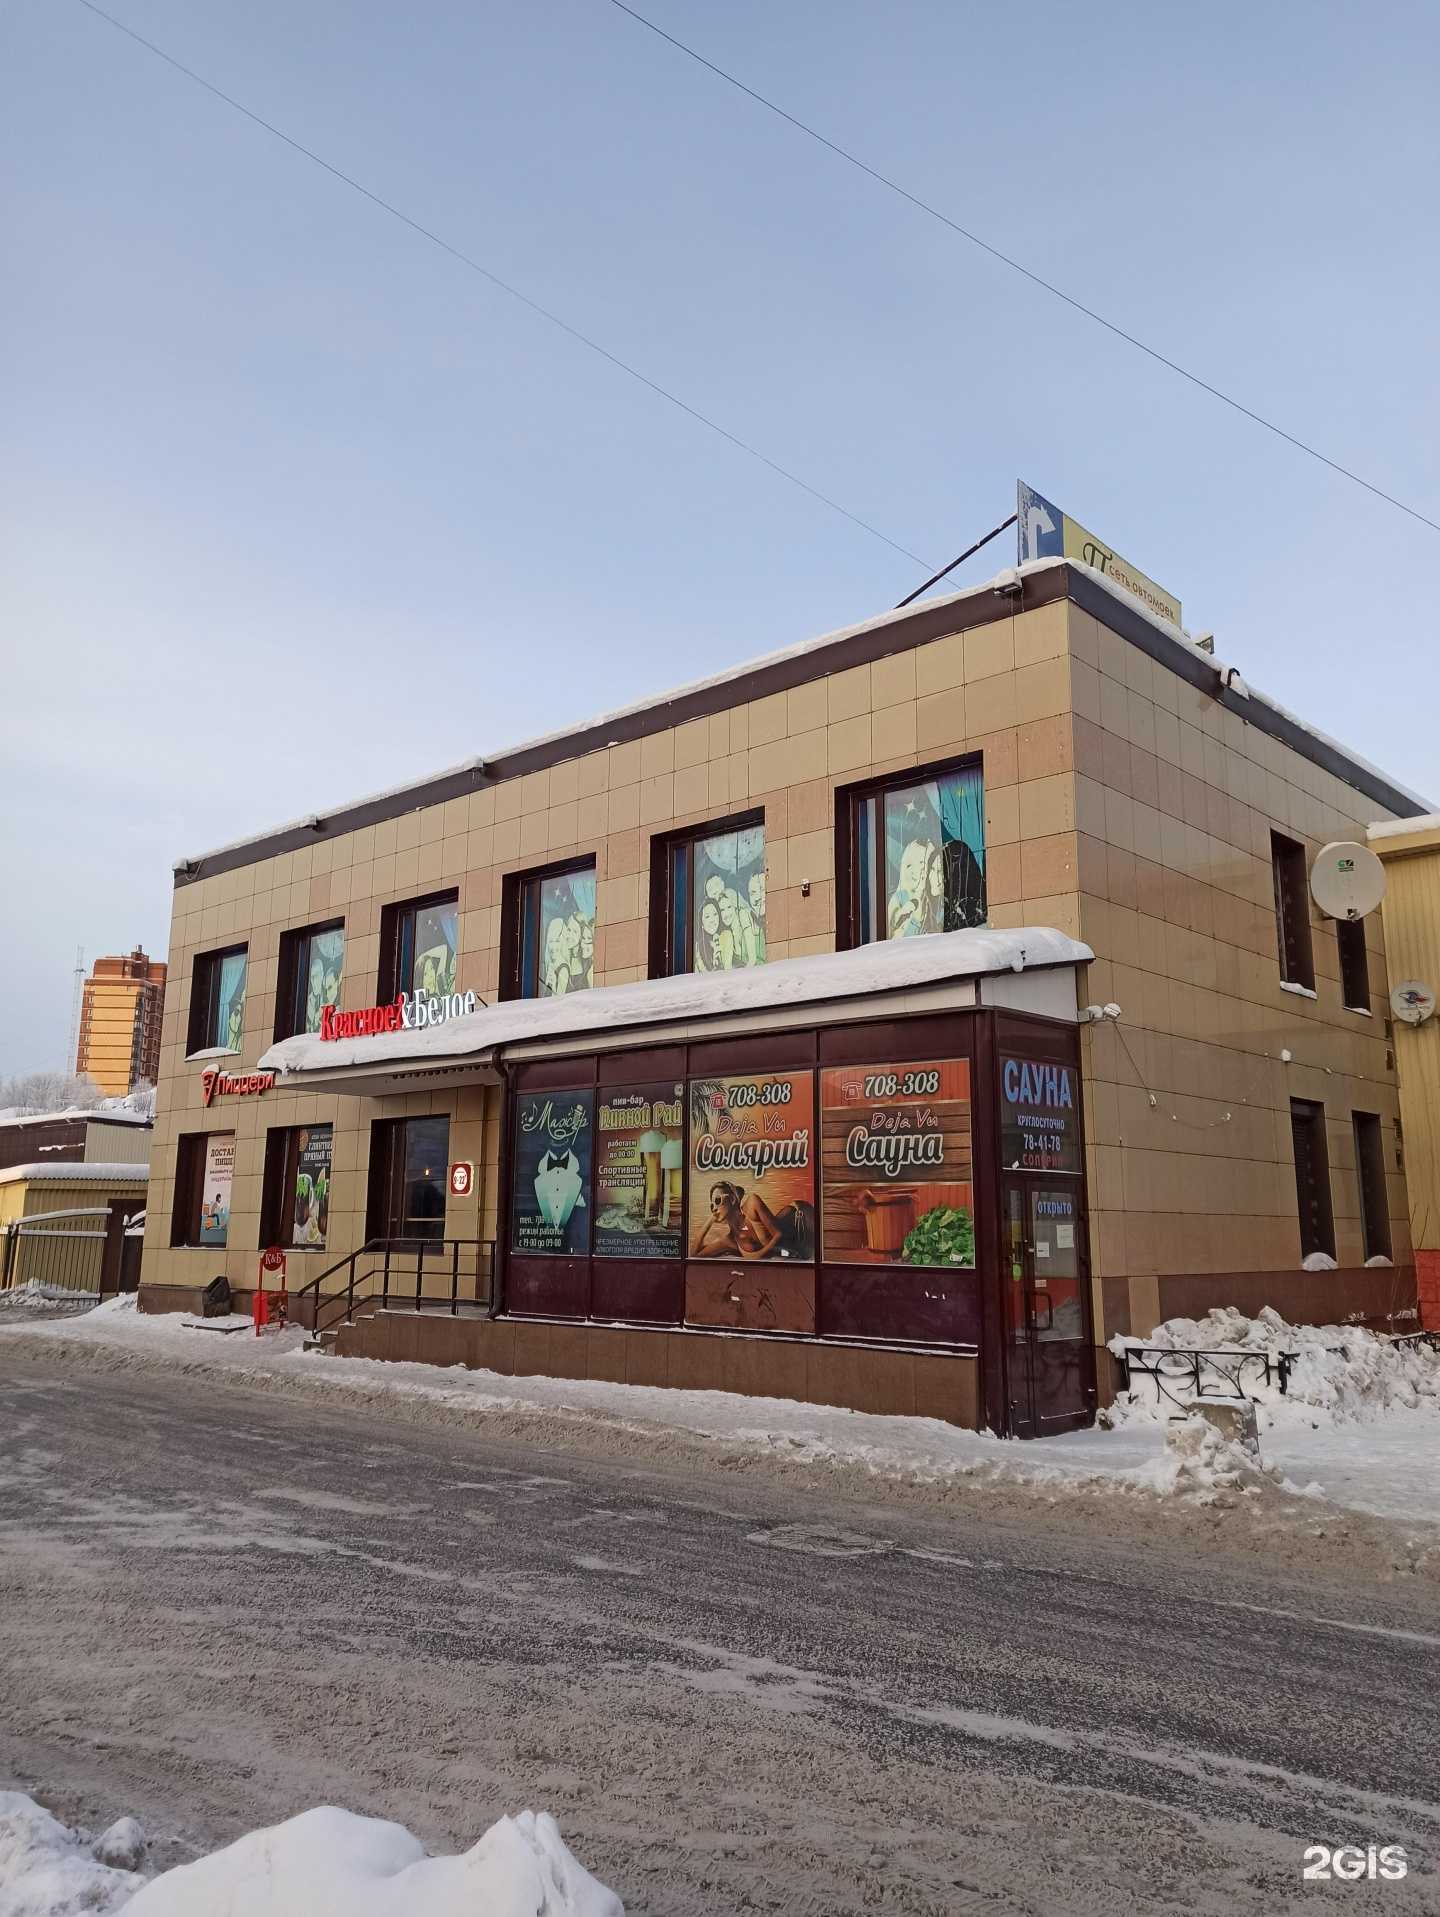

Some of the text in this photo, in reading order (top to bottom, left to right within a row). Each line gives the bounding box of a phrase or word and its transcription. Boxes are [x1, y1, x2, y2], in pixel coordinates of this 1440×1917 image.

[214, 1073, 274, 1096] Пиццери
[728, 1083, 791, 1107] 708-308
[865, 1071, 939, 1097] 708-308
[1004, 1060, 1073, 1108] САУНА
[717, 1111, 786, 1139] Deja Vu
[871, 1108, 939, 1134] Deja Vu
[1017, 1115, 1065, 1130] КРУГЛОСУТОЧНО
[696, 1129, 808, 1179] Солярий
[846, 1125, 944, 1177] Сауна
[598, 1165, 647, 1176] Спортивные
[599, 1177, 647, 1189] трансляции
